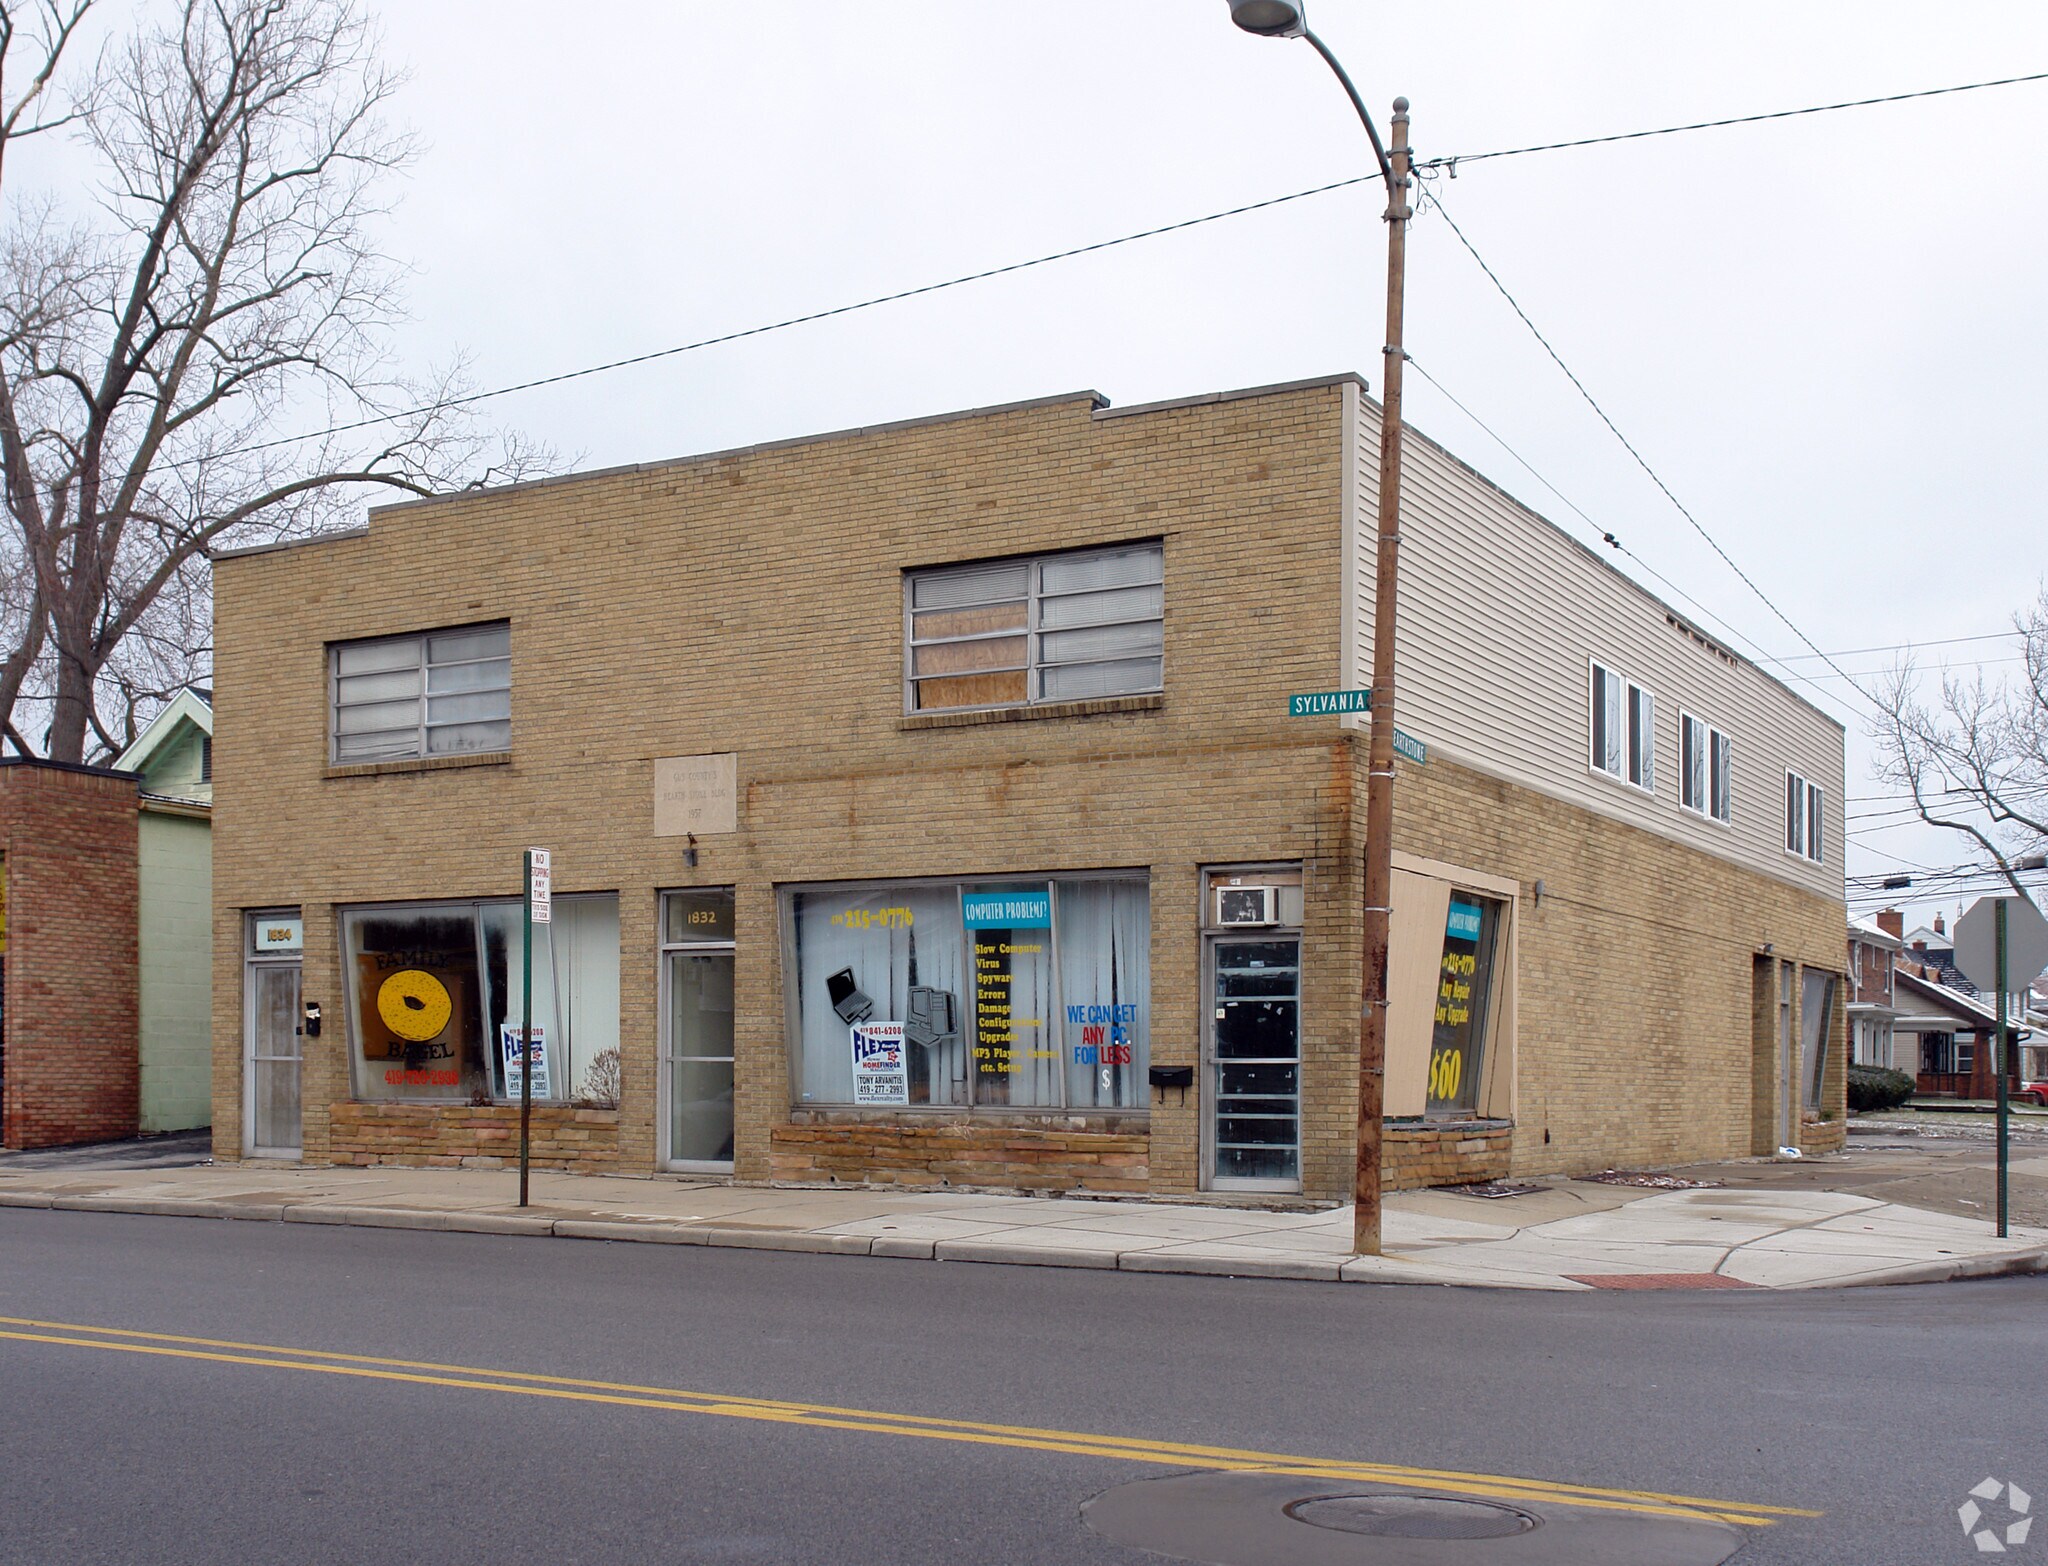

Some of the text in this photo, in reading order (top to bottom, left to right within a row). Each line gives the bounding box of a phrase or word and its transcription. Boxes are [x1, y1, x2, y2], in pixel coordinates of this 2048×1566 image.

[1295, 692, 1365, 714] SYLVANIA
[1393, 730, 1424, 761] EARTHSTONE
[535, 853, 545, 864] NO
[534, 880, 545, 888] ANY
[533, 889, 546, 899] TIME
[966, 900, 1047, 920] COMPUTER PROBLEMS?
[687, 911, 717, 924] 1832
[845, 906, 914, 929] 215-0776
[975, 943, 1041, 954] Slow Computer
[375, 950, 450, 970] FAMILY
[976, 958, 1000, 968] Virus
[977, 972, 1014, 985] Spyware
[978, 989, 1006, 999] Errors
[978, 1003, 1012, 1015] Damage
[1067, 1004, 1136, 1023] WE CAN GET
[869, 1027, 901, 1035] 841-6208
[1083, 1026, 1131, 1045] ANY P.C.
[387, 1041, 454, 1059] BAGEL
[972, 1048, 990, 1059] MP3
[1075, 1046, 1131, 1064] FOR LESS
[981, 1064, 995, 1072] etc.
[1429, 1049, 1461, 1100] $60
[859, 1076, 902, 1084] TONY ARVANITIS
[1102, 1069, 1111, 1090] $
[860, 1085, 871, 1094] 419
[875, 1085, 885, 1093] 277
[889, 1085, 903, 1094] 2993
